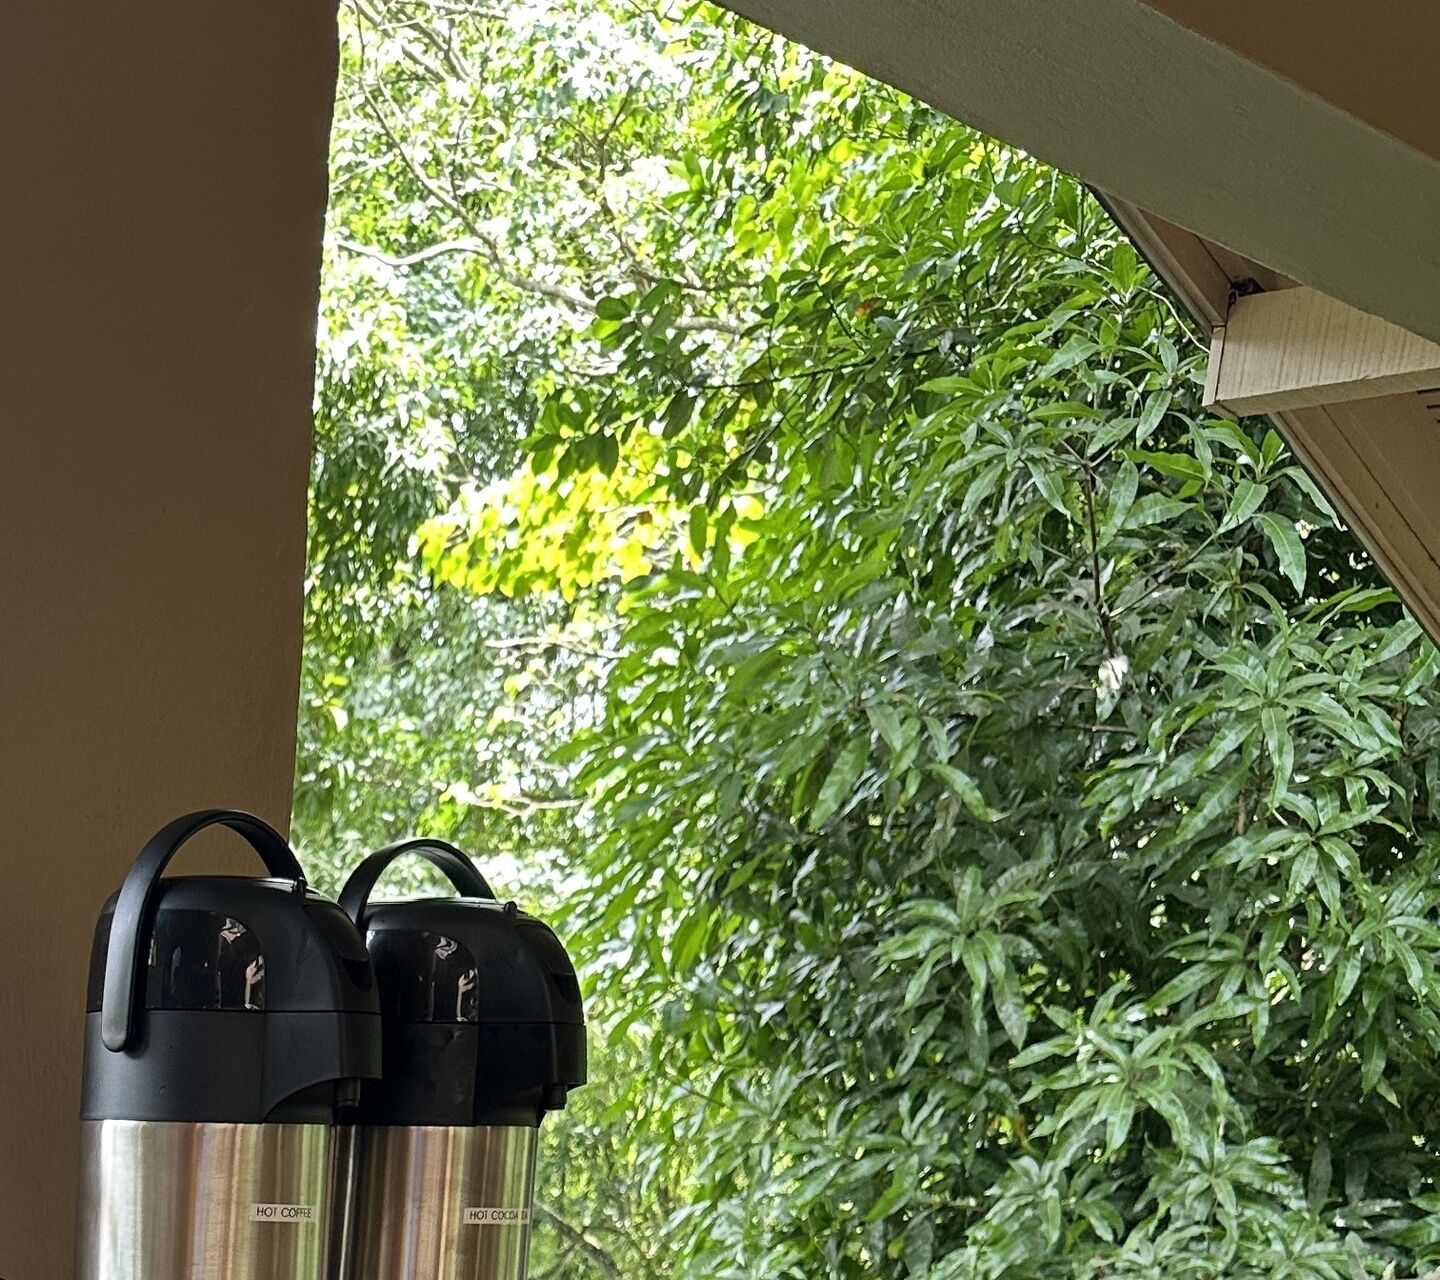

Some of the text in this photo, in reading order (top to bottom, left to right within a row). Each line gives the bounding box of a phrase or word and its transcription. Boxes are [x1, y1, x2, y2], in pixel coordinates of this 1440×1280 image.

[256, 1206, 311, 1218] HOT COFFEE
[469, 1210, 488, 1220] HOT
[491, 1210, 518, 1220] COCOA
